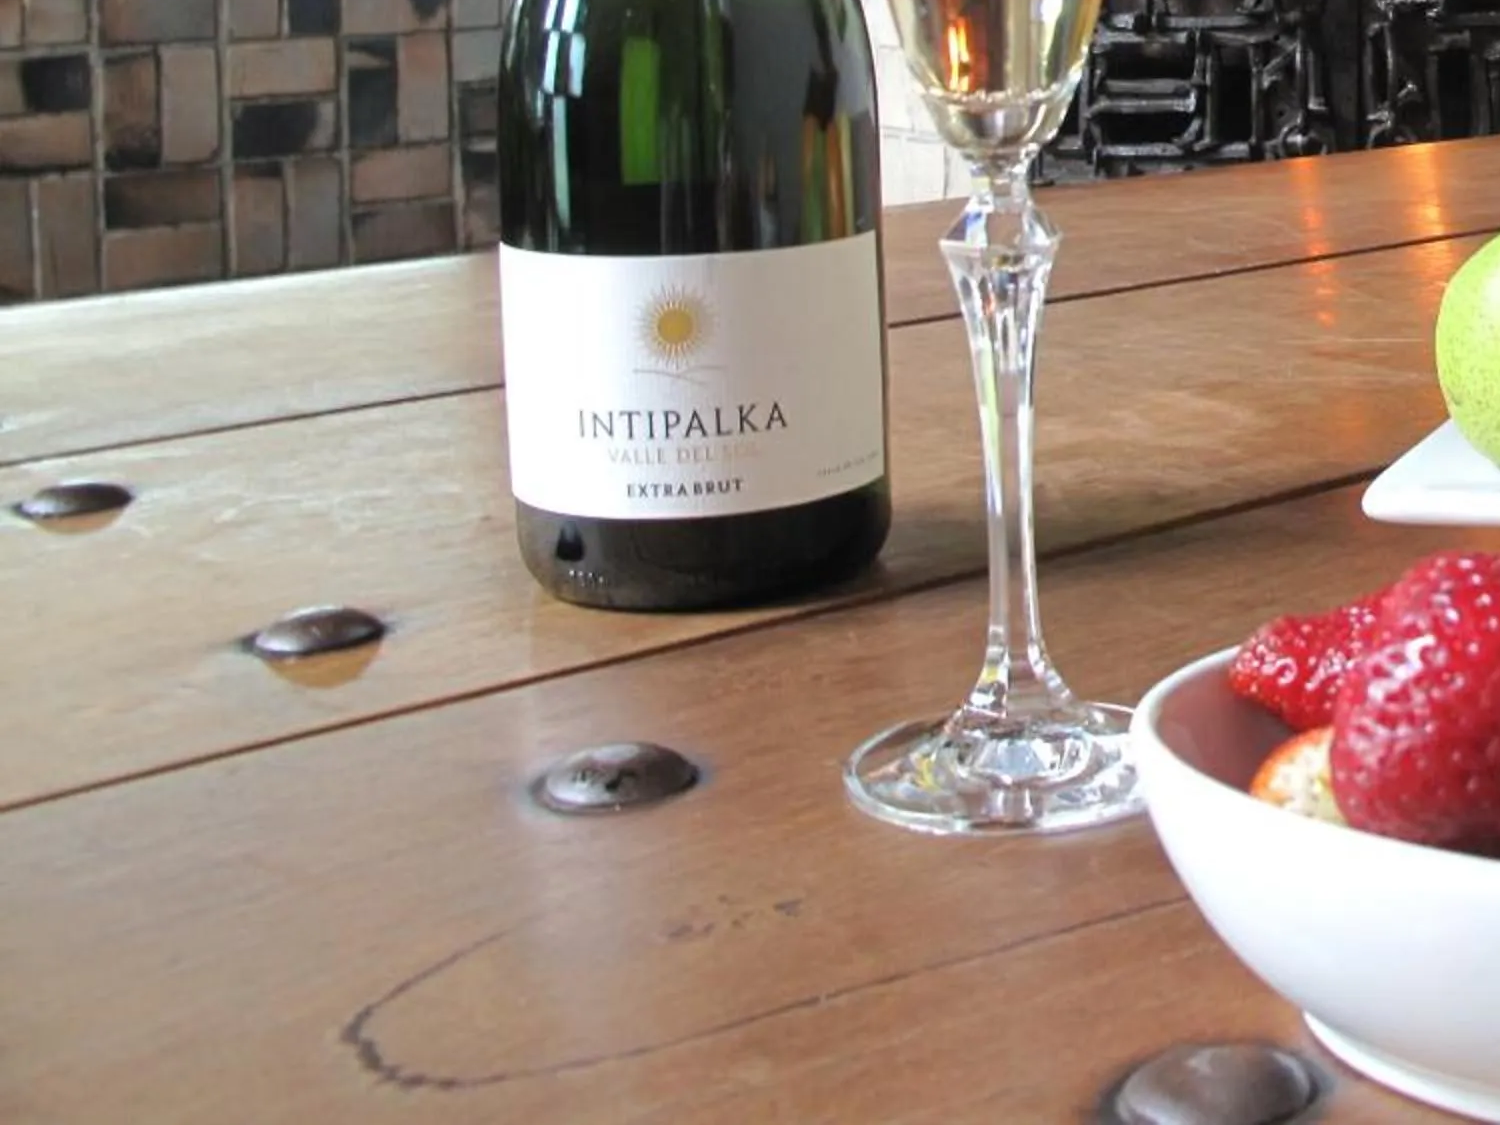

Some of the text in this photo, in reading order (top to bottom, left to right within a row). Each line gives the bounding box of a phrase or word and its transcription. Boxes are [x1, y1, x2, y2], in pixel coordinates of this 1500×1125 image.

[578, 401, 788, 440] INTIPALKA
[607, 446, 668, 466] VALLE
[677, 445, 714, 464] DEL
[626, 478, 743, 499] EXTRA BRUT
